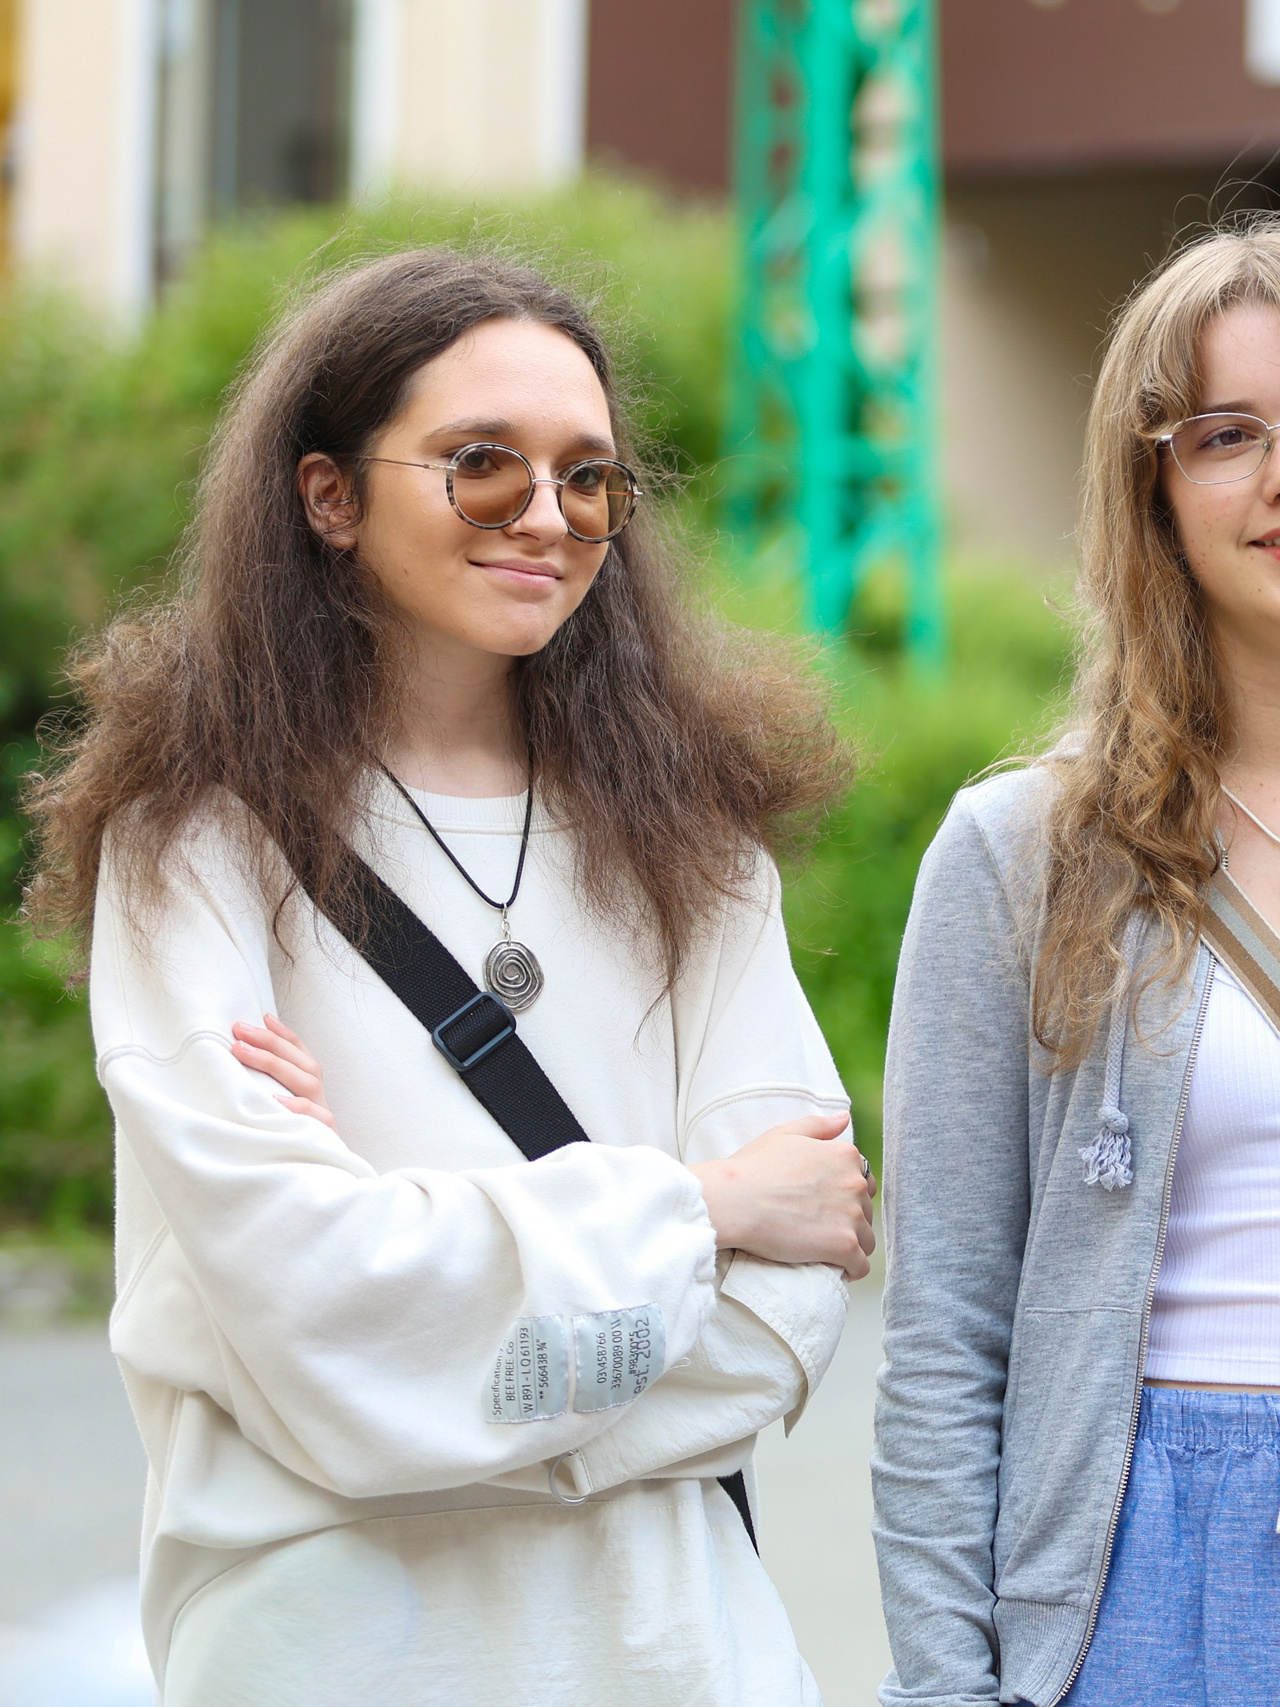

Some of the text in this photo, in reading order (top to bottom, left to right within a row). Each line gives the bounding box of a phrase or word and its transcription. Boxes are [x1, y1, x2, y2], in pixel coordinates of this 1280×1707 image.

[520, 1328, 529, 1356] 61193
[611, 1331, 622, 1343] 00
[521, 1358, 530, 1367] Q
[596, 1332, 607, 1384] 03\458766
[611, 1345, 623, 1390] 33670089
[633, 1317, 651, 1394] est. 2002
[538, 1353, 549, 1388] 566438
[491, 1355, 503, 1415] Specification
[505, 1385, 516, 1401] BEE
[522, 1384, 533, 1401] 891
[524, 1402, 533, 1412] W
